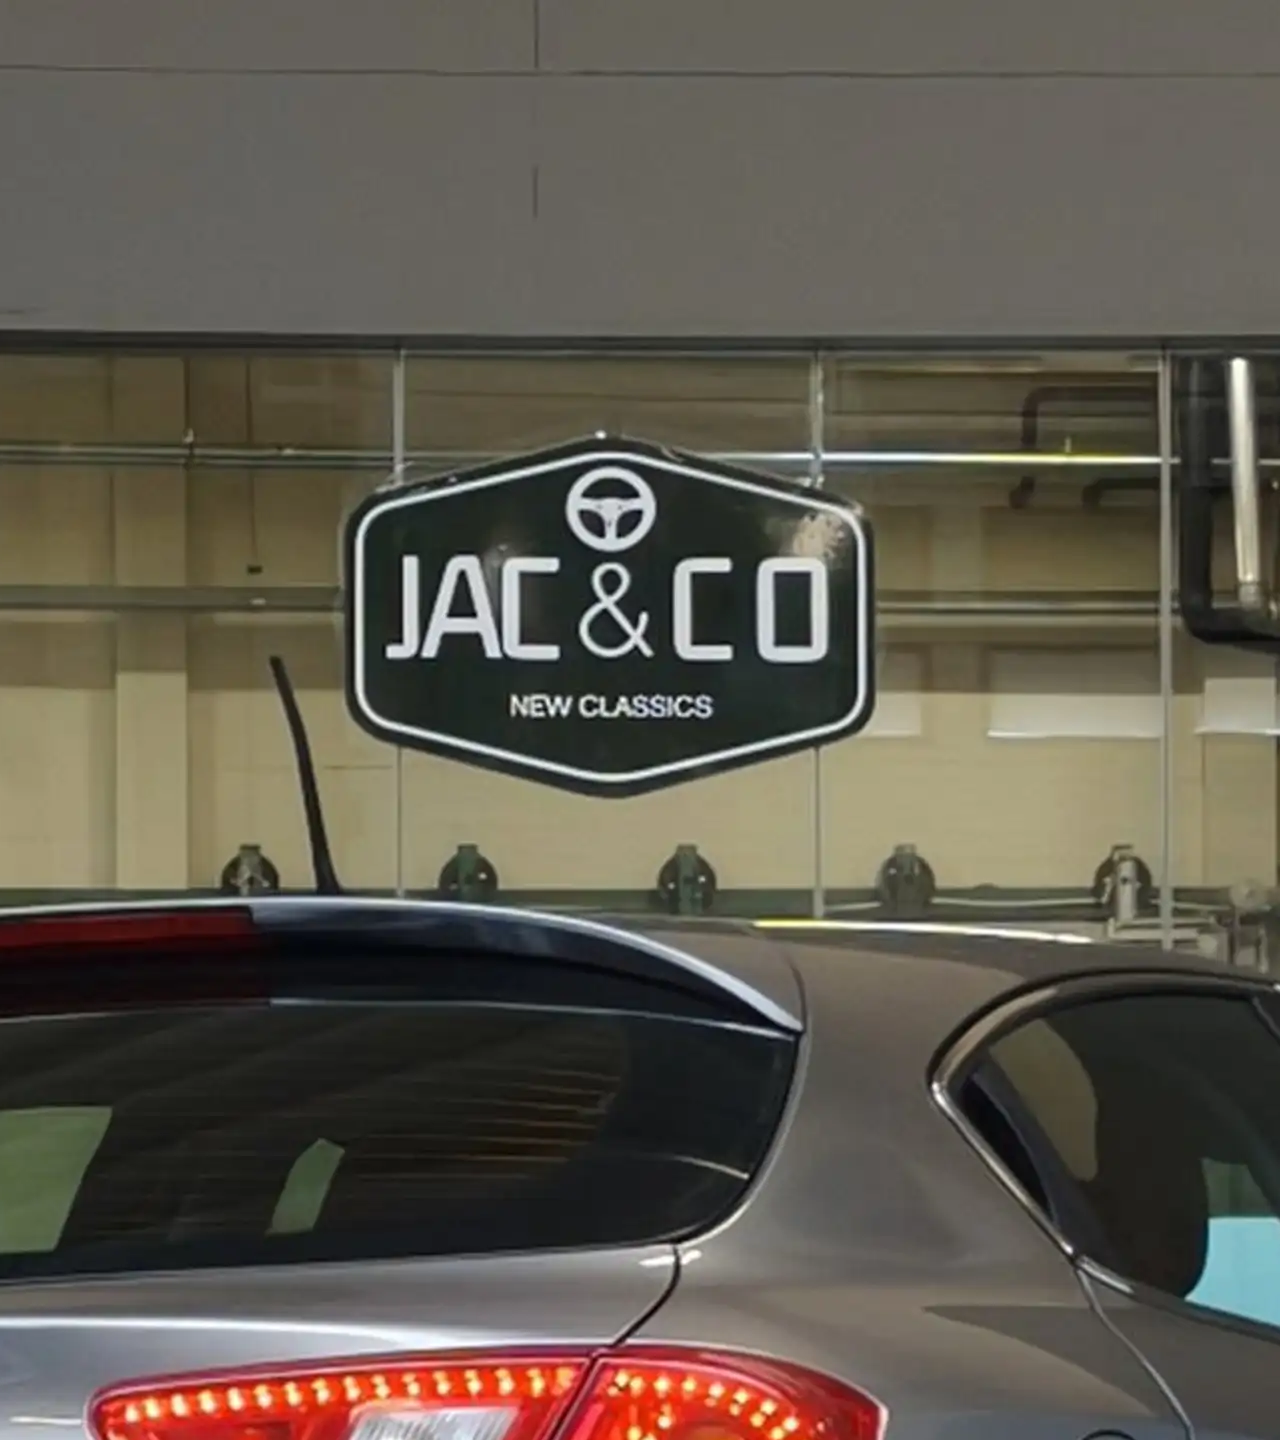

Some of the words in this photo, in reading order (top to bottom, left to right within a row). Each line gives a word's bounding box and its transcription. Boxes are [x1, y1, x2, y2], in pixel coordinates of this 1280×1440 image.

[385, 555, 560, 660] JAC
[579, 562, 654, 658] &
[674, 557, 829, 662] CO
[510, 694, 572, 718] NEW
[578, 694, 712, 718] CLASSICS
